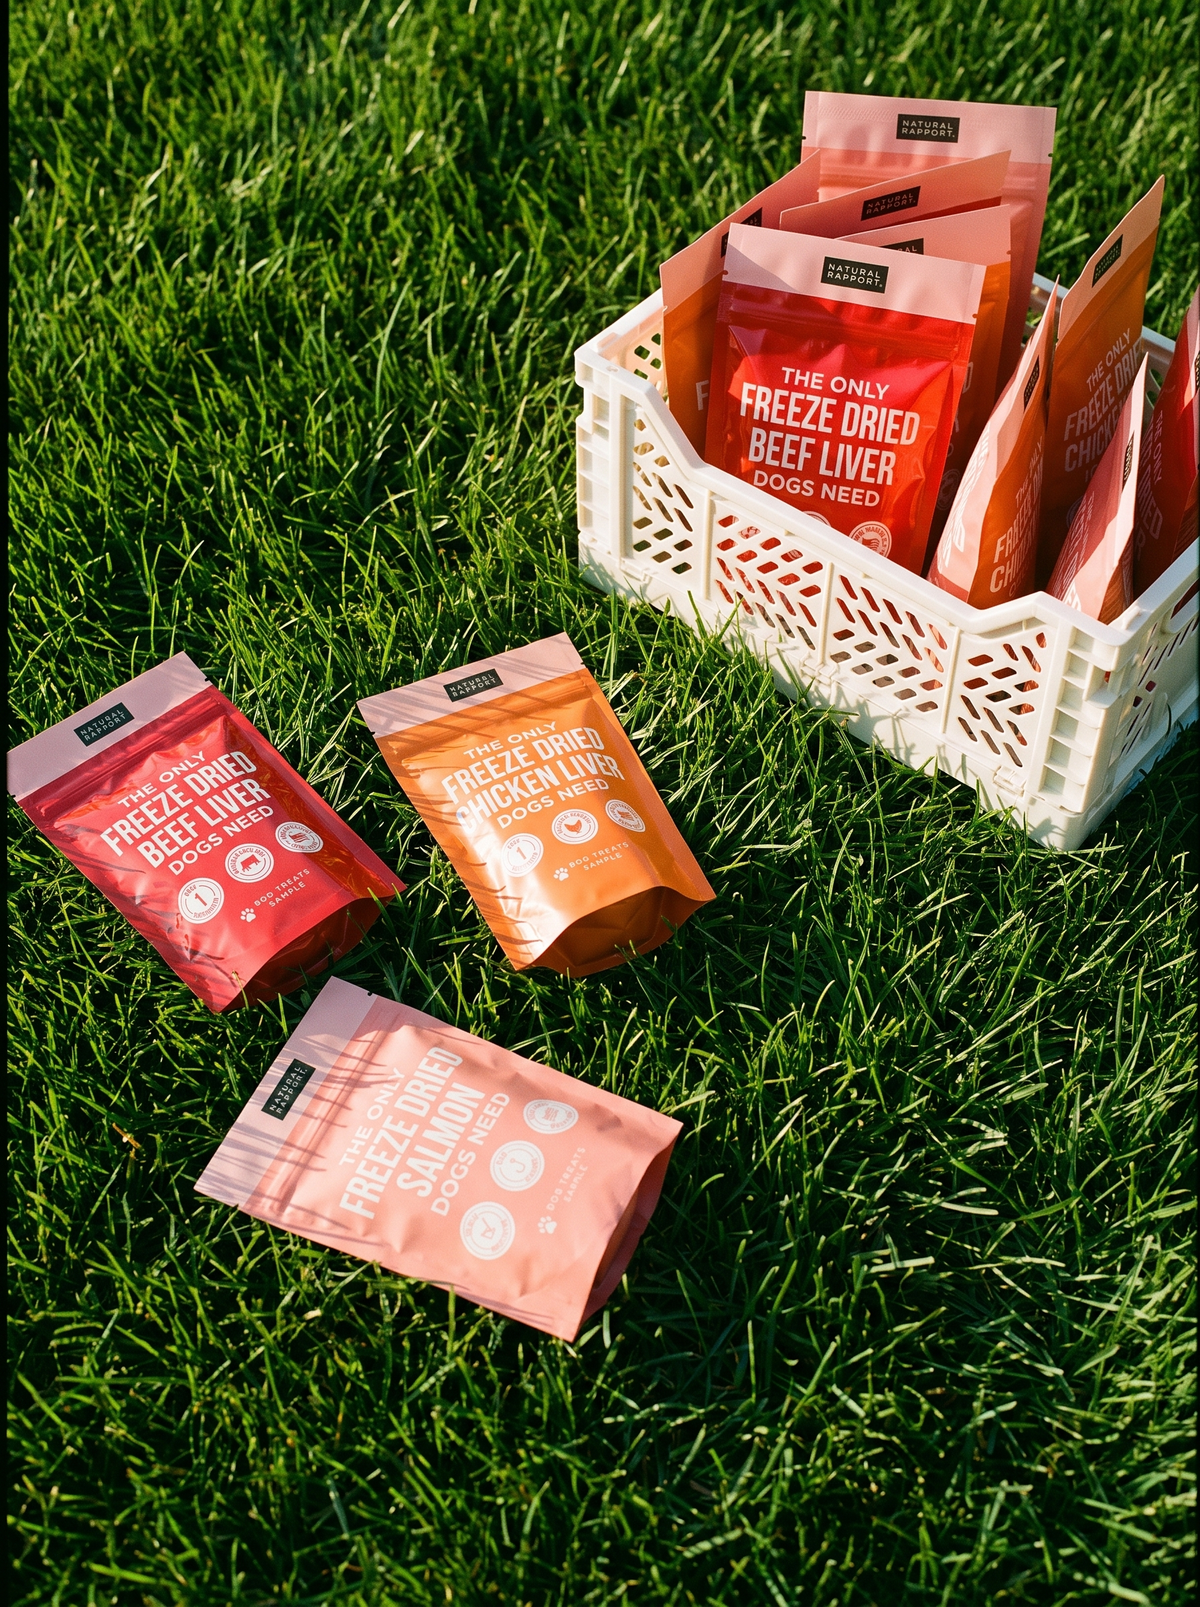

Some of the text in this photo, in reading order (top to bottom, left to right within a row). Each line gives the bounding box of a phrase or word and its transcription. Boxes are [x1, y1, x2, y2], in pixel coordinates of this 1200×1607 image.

[902, 120, 954, 130] NATURAL
[867, 193, 914, 208] NATURAL
[828, 263, 881, 279] NATURAL
[781, 366, 890, 400] THE ONLY
[1086, 327, 1131, 392] THE ONLY
[739, 382, 837, 434] FREEZE
[840, 400, 921, 446] DRIED
[1063, 373, 1115, 441] FREEZE
[748, 426, 897, 486] BEEF LIVER
[753, 470, 880, 507] DOGS NEED
[441, 726, 605, 806] FREEZE DRIED
[463, 721, 557, 760] THE ONLY
[100, 751, 257, 857] FREEZE DRIED
[117, 750, 206, 808] THE ONLY
[456, 764, 561, 835] CHICKEN
[556, 752, 626, 781] LIVER
[496, 795, 554, 829] DOGS
[557, 778, 610, 802] NEED
[136, 812, 198, 869] BEEF
[193, 778, 271, 827] LIVER
[168, 832, 223, 876] DOGS
[222, 805, 274, 838] NEED
[592, 841, 629, 858] TREATS
[275, 868, 310, 891] TREATS
[583, 852, 622, 871] SAMPLE
[269, 881, 306, 907] SAMPLE
[339, 1067, 405, 1166] THE ONLY
[339, 1046, 464, 1220] FREEZE DRIED
[396, 1082, 486, 1198] SALMON
[431, 1092, 510, 1216] DOGS NEED
